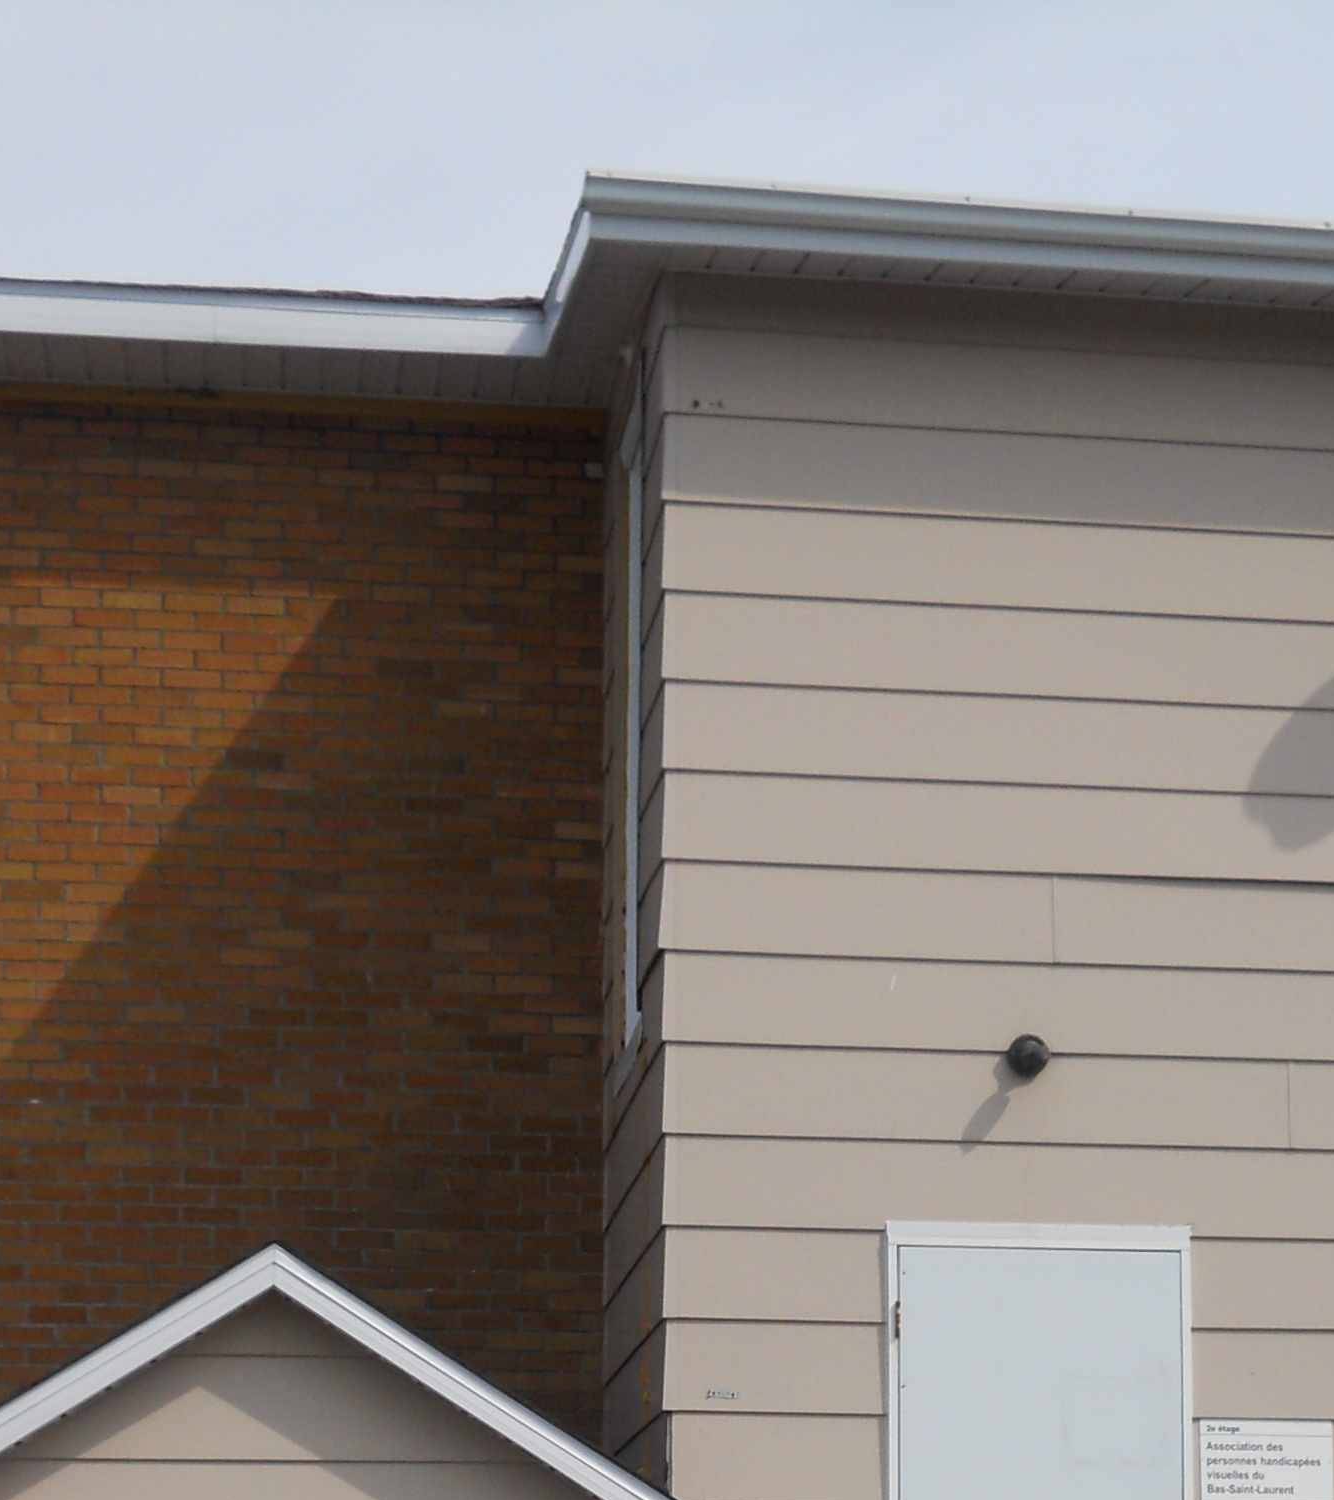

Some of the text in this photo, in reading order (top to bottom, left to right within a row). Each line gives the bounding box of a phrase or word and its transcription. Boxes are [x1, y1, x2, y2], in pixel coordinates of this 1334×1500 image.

[1206, 1441, 1284, 1452] Association des
[1206, 1457, 1322, 1468] personnes handicapées
[1207, 1471, 1265, 1480] visuelles du
[1207, 1484, 1295, 1495] Bas-Saint-Laurent
